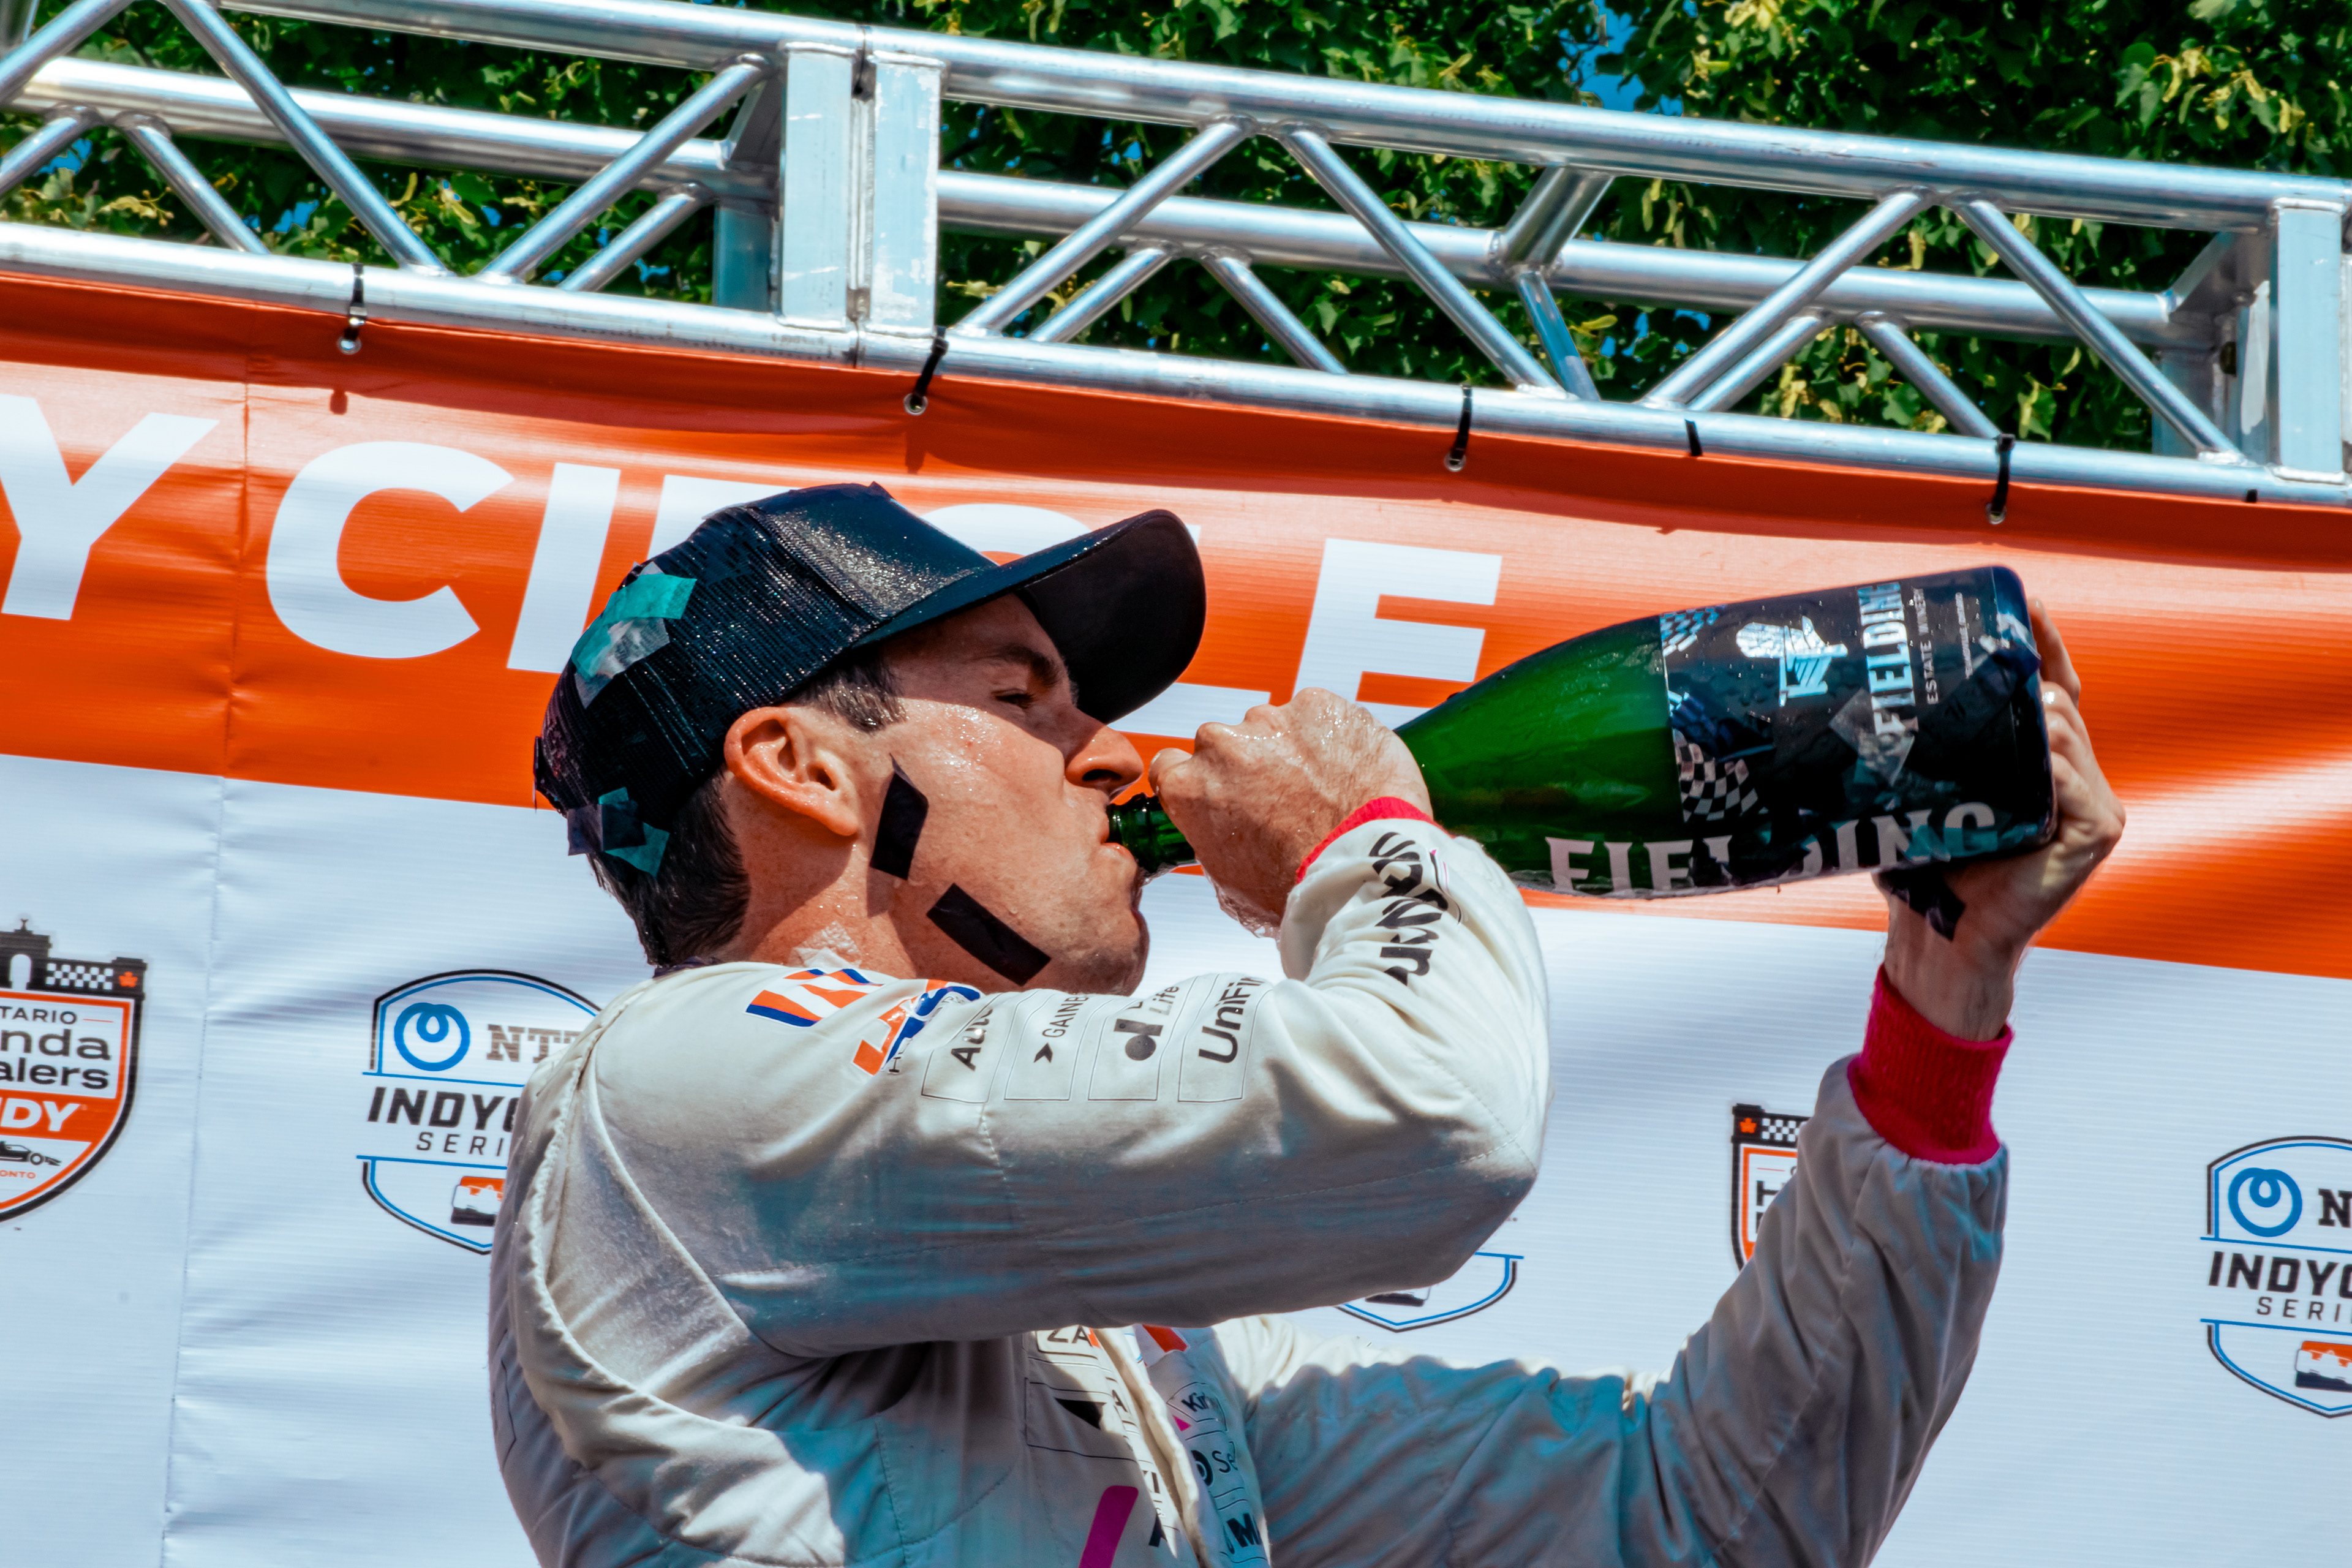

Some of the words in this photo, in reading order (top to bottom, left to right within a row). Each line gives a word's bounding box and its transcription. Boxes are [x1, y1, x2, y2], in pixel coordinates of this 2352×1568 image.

[1918, 641, 1939, 704] ESTATE
[1149, 986, 1174, 1016] Life
[0, 1097, 81, 1132] DY
[2256, 1297, 2352, 1324] SERI
